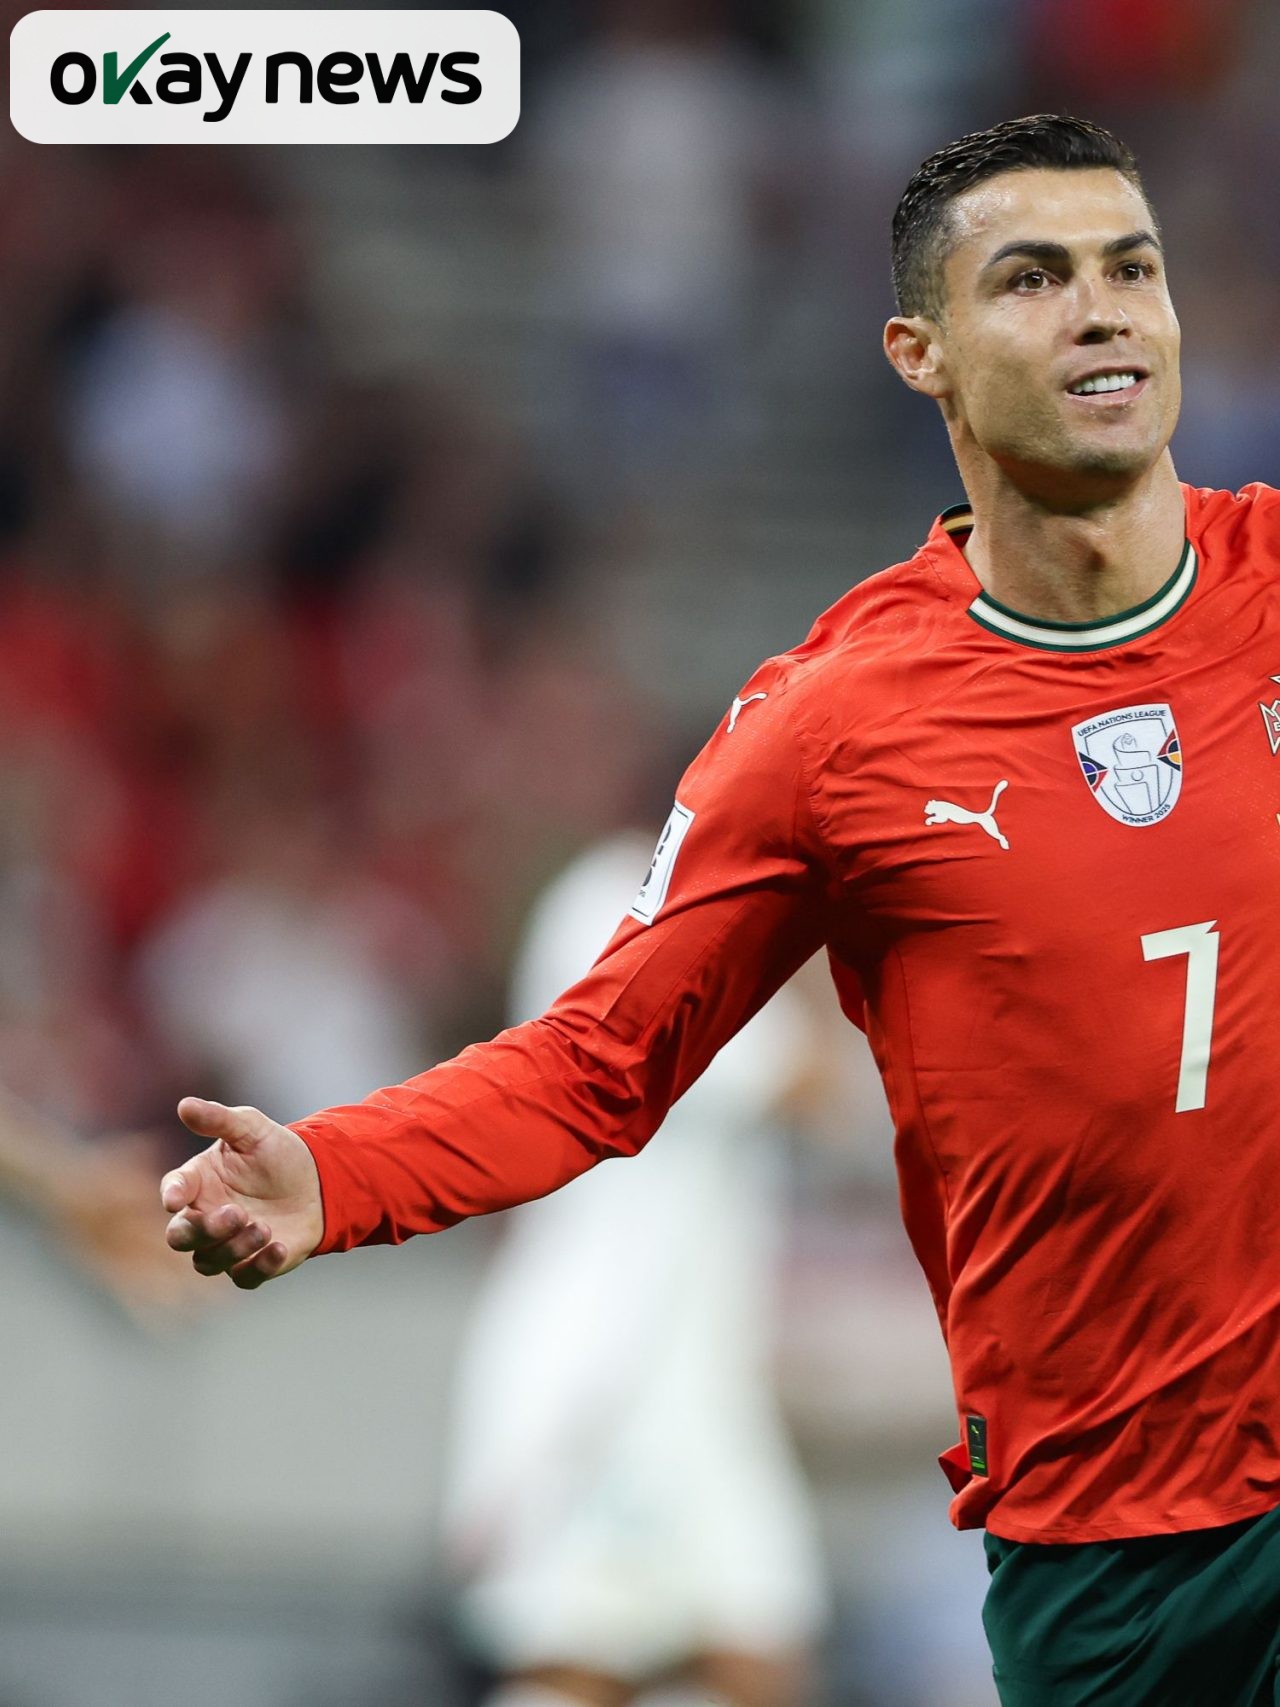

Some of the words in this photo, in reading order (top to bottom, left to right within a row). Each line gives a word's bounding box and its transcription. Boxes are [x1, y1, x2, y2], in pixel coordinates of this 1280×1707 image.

[1077, 724, 1098, 737] UEFA
[1098, 712, 1133, 727] NATIONS
[1134, 709, 1167, 719] LEAGUE
[1122, 814, 1154, 823] WINNER
[1140, 919, 1221, 1114] 7
